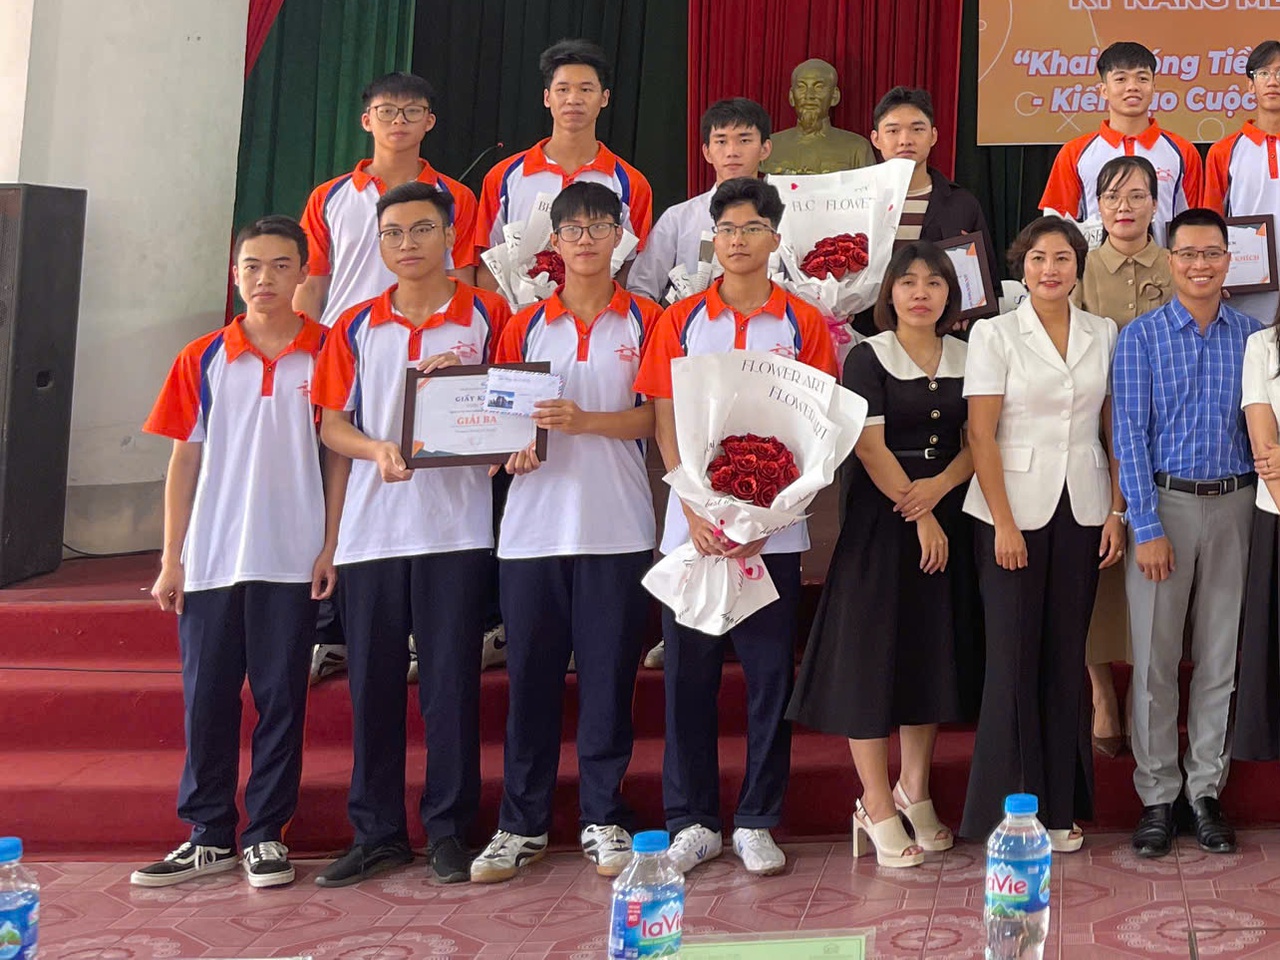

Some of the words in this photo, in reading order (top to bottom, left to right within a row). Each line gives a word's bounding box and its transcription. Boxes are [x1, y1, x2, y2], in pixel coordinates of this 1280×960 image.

[1208, 46, 1253, 74] Tiề
[1186, 84, 1258, 118] Cuộc
[741, 358, 801, 384] FLOWER
[802, 375, 827, 394] ART
[483, 415, 497, 424] BA
[642, 910, 683, 938] laVi
